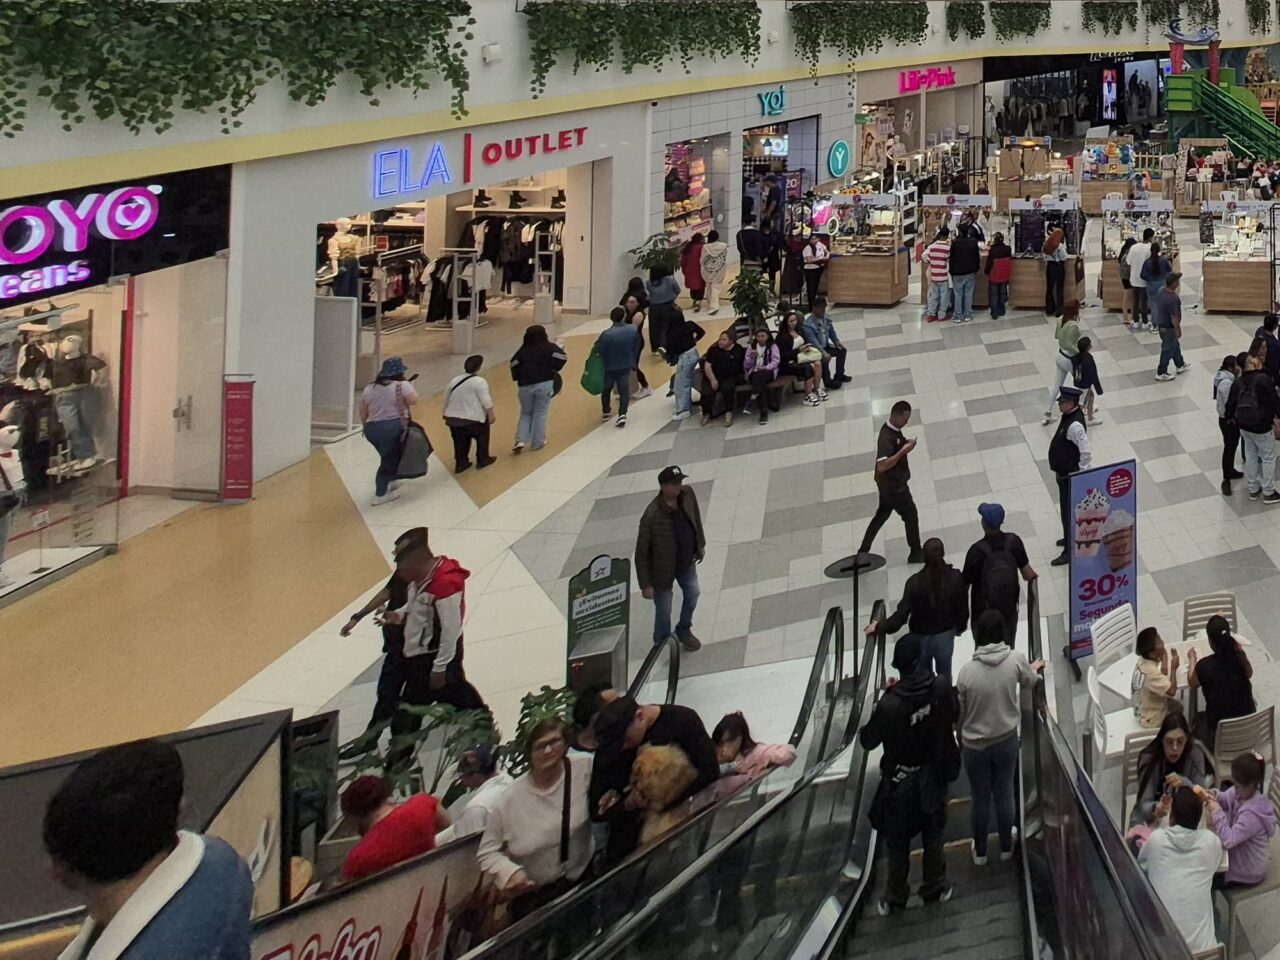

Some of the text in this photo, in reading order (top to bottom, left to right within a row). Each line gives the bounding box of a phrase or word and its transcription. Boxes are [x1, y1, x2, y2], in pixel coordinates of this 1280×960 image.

[373, 127, 589, 200] ELA OUTLET
[1078, 572, 1130, 602] 30%
